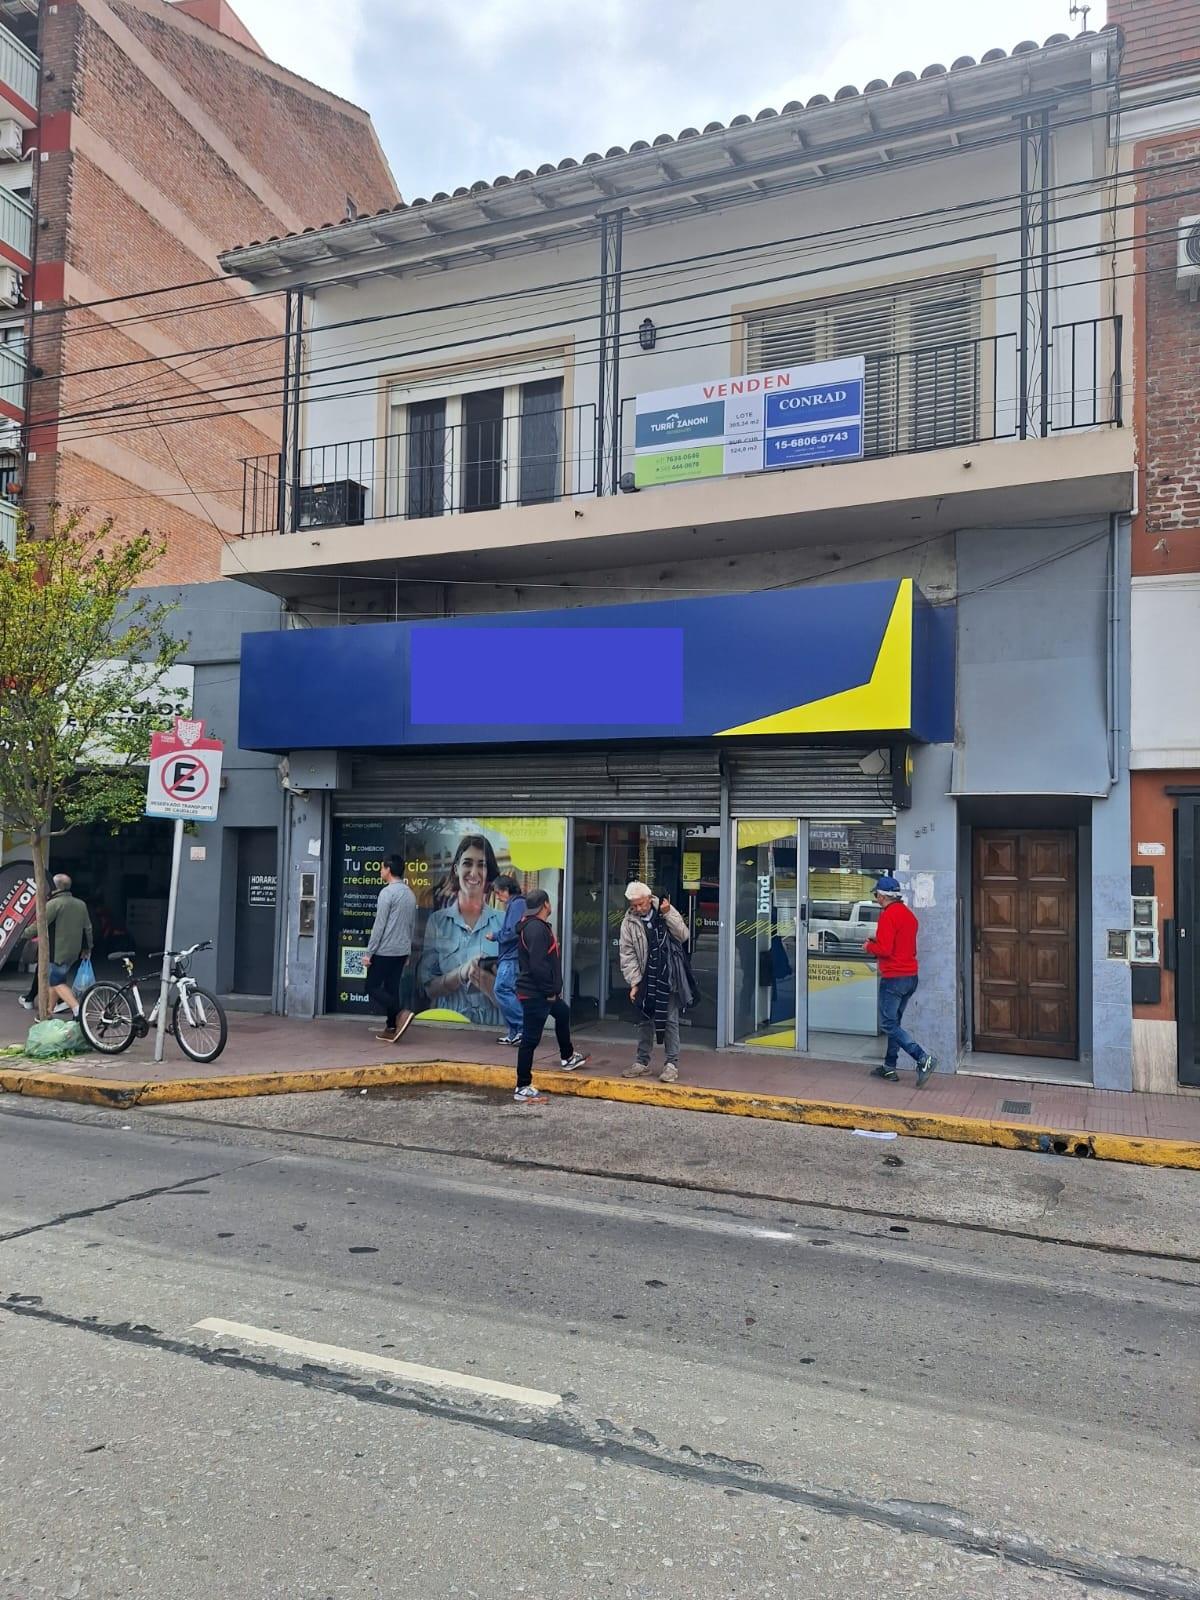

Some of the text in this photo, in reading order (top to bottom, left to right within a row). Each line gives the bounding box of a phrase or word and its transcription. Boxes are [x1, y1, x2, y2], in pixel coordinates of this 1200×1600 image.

[703, 373, 790, 399] VENDEN
[779, 390, 847, 410] CONRAD
[677, 416, 708, 429] ZANONI
[736, 412, 753, 420] LOTE
[774, 431, 848, 450] 15-6806-0743
[344, 858, 361, 871] Tu
[411, 878, 431, 887] vos.
[757, 875, 770, 914] bind
[818, 969, 841, 977] SOBRE
[350, 993, 370, 1002] bind
